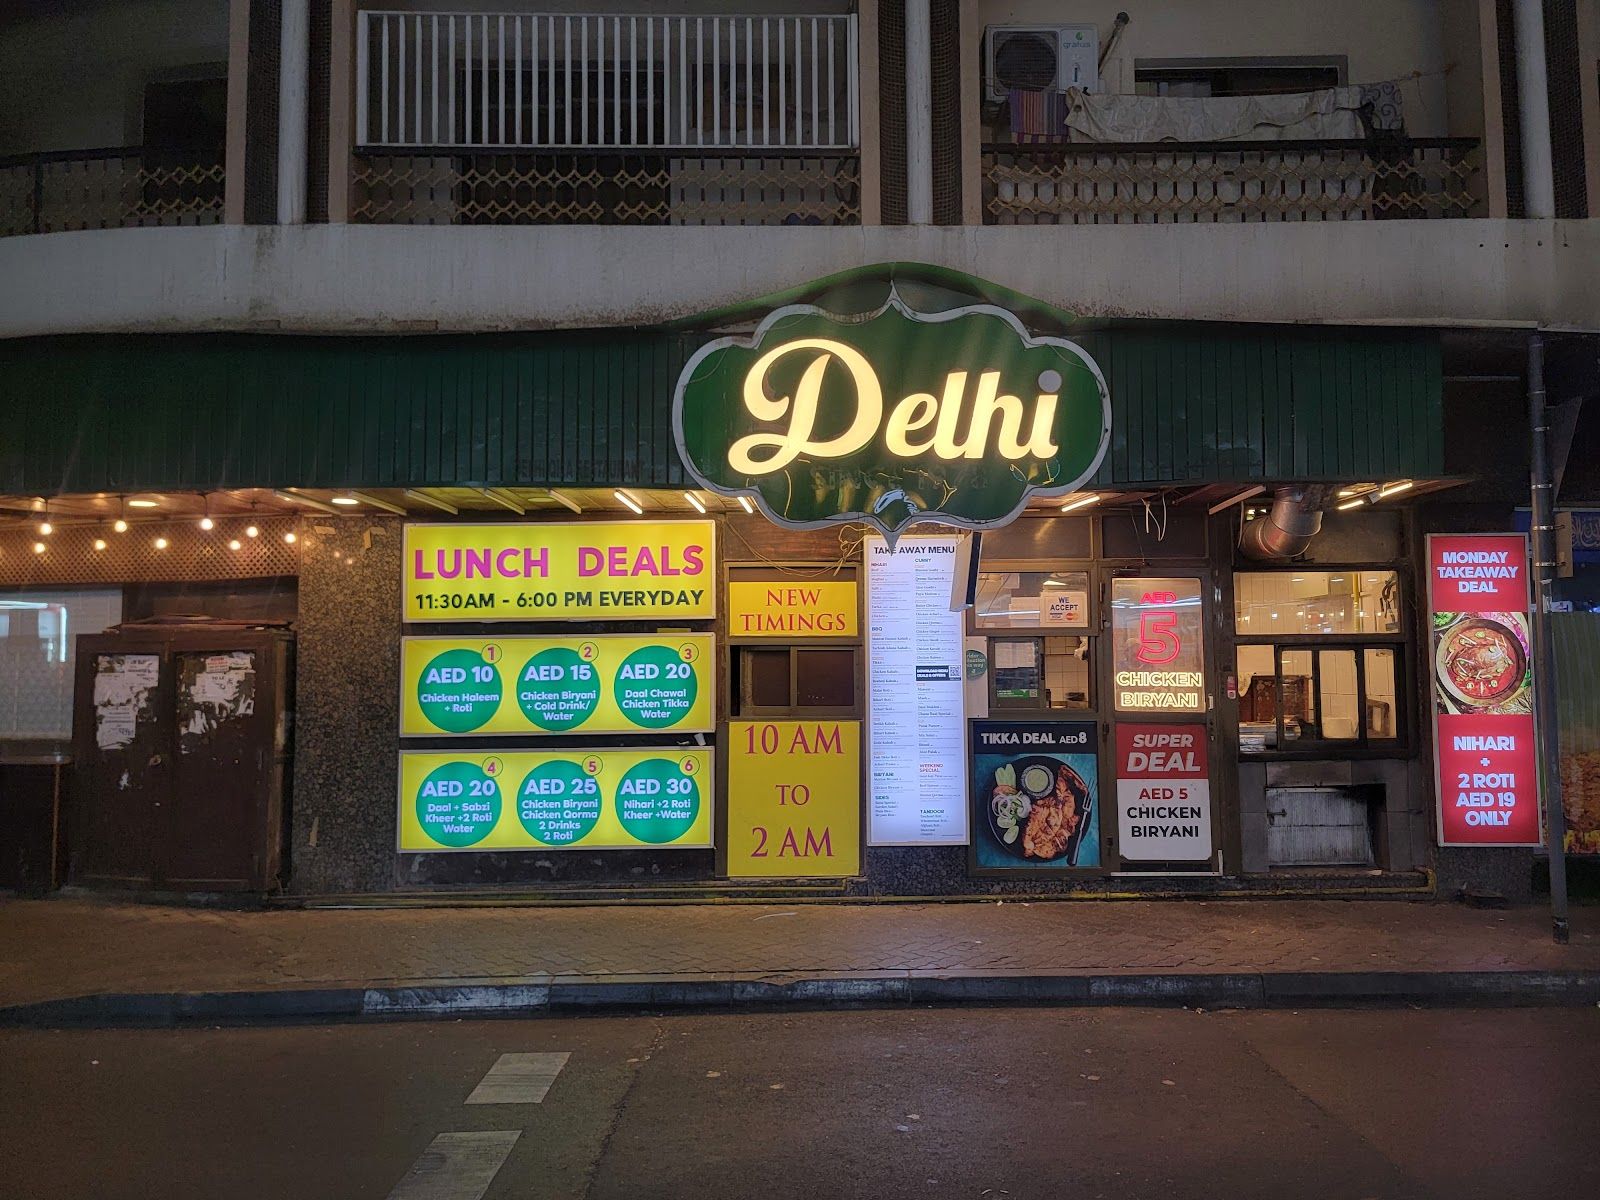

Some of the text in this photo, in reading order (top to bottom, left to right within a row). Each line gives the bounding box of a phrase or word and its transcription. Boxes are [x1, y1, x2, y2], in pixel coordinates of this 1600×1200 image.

[728, 338, 1062, 475] Delhi
[899, 546, 926, 554] AWAY
[928, 546, 955, 554] MENU
[414, 546, 704, 579] LUNCH DEALS
[1443, 552, 1508, 564] MONDAY
[1437, 567, 1518, 579] TAKEAWAY
[1458, 581, 1498, 593] DEAL
[516, 592, 557, 608] 6:00
[564, 591, 592, 607] PM
[600, 590, 704, 606] EVERYDAY
[766, 589, 822, 606] NEW
[1140, 592, 1177, 604] AED
[740, 613, 846, 631] TIMINGS
[1136, 611, 1180, 665] 5
[487, 647, 495, 660] 1
[584, 646, 592, 657] 2
[684, 648, 692, 659] 3
[426, 666, 493, 684] AED 10
[524, 665, 592, 681] AED 15
[620, 663, 691, 680] AED 20
[1116, 671, 1202, 687] CHICKEN
[421, 693, 499, 702] Chicken Haleem
[521, 690, 596, 701] Chicken Biryani
[625, 689, 686, 698] Daal Chawal
[1120, 692, 1198, 707] BIRYANI
[453, 703, 472, 712] Roti
[534, 702, 556, 710] Cold
[559, 700, 591, 710] Drink/
[622, 699, 689, 708] Chicken Tikka
[543, 712, 574, 720] Water
[640, 710, 671, 718] Water
[745, 724, 844, 754] 10 AM
[981, 733, 1020, 744] TIKKA
[1022, 732, 1056, 744] DEAL
[1132, 734, 1193, 748] SUPER
[1453, 736, 1515, 751] NIHARI
[589, 761, 597, 772] 5
[685, 760, 693, 771] 6
[1126, 752, 1201, 772] DEAL
[1480, 757, 1490, 766] +
[488, 762, 496, 774] 4
[524, 778, 597, 795] AED 25
[620, 778, 692, 795] AED 30
[1458, 773, 1515, 788] 2 ROTI
[422, 780, 496, 797] AED 20
[1139, 788, 1188, 799] AED 5
[775, 785, 810, 806] TO
[1456, 792, 1515, 807] AED 19
[428, 803, 451, 812] Daal
[462, 802, 490, 811] Sabzi
[522, 799, 598, 810] Chicken Biryani
[624, 800, 654, 809] Nihari
[672, 799, 691, 808] Roti
[425, 814, 455, 823] Kheer
[473, 813, 492, 821] Roti
[522, 810, 597, 819] Chicken Qorma
[624, 811, 653, 819] Kheer
[1126, 807, 1201, 818] CHICKEN
[1465, 810, 1513, 826] ONLY
[443, 825, 474, 833] Water
[549, 821, 581, 829] Drinks
[544, 831, 573, 840] 2 Roti
[1131, 826, 1199, 838] BIRYANI
[751, 826, 834, 857] 2 AM
